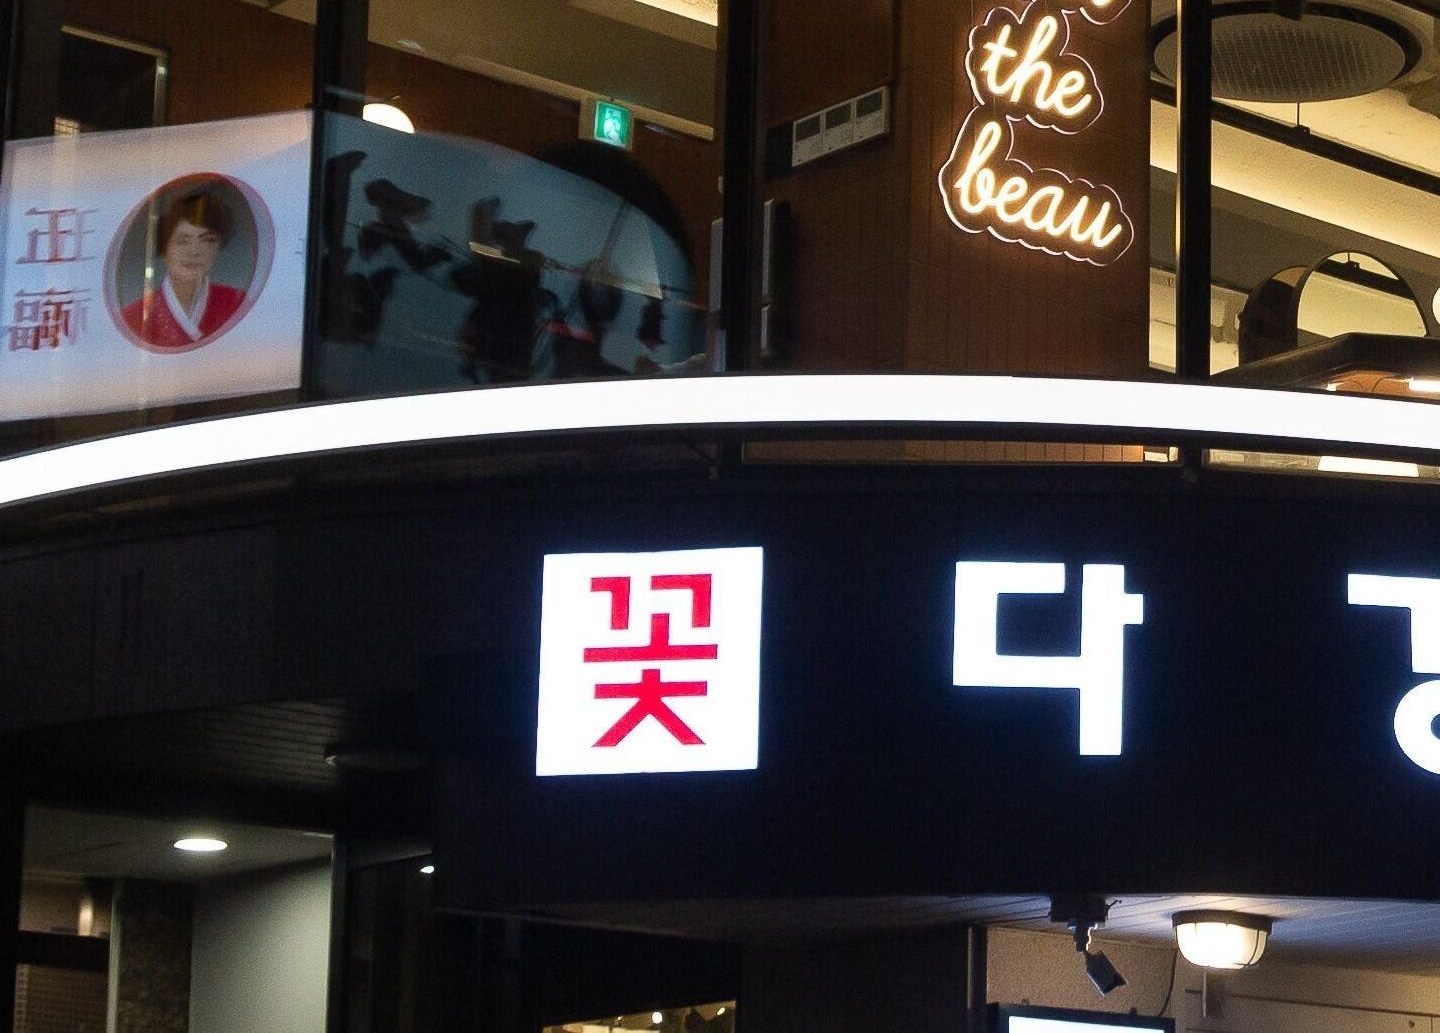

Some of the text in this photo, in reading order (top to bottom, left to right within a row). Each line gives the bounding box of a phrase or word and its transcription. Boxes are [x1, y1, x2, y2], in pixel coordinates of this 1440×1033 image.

[981, 14, 1092, 118] the
[954, 120, 1123, 250] beau
[583, 572, 719, 748] 꽃
